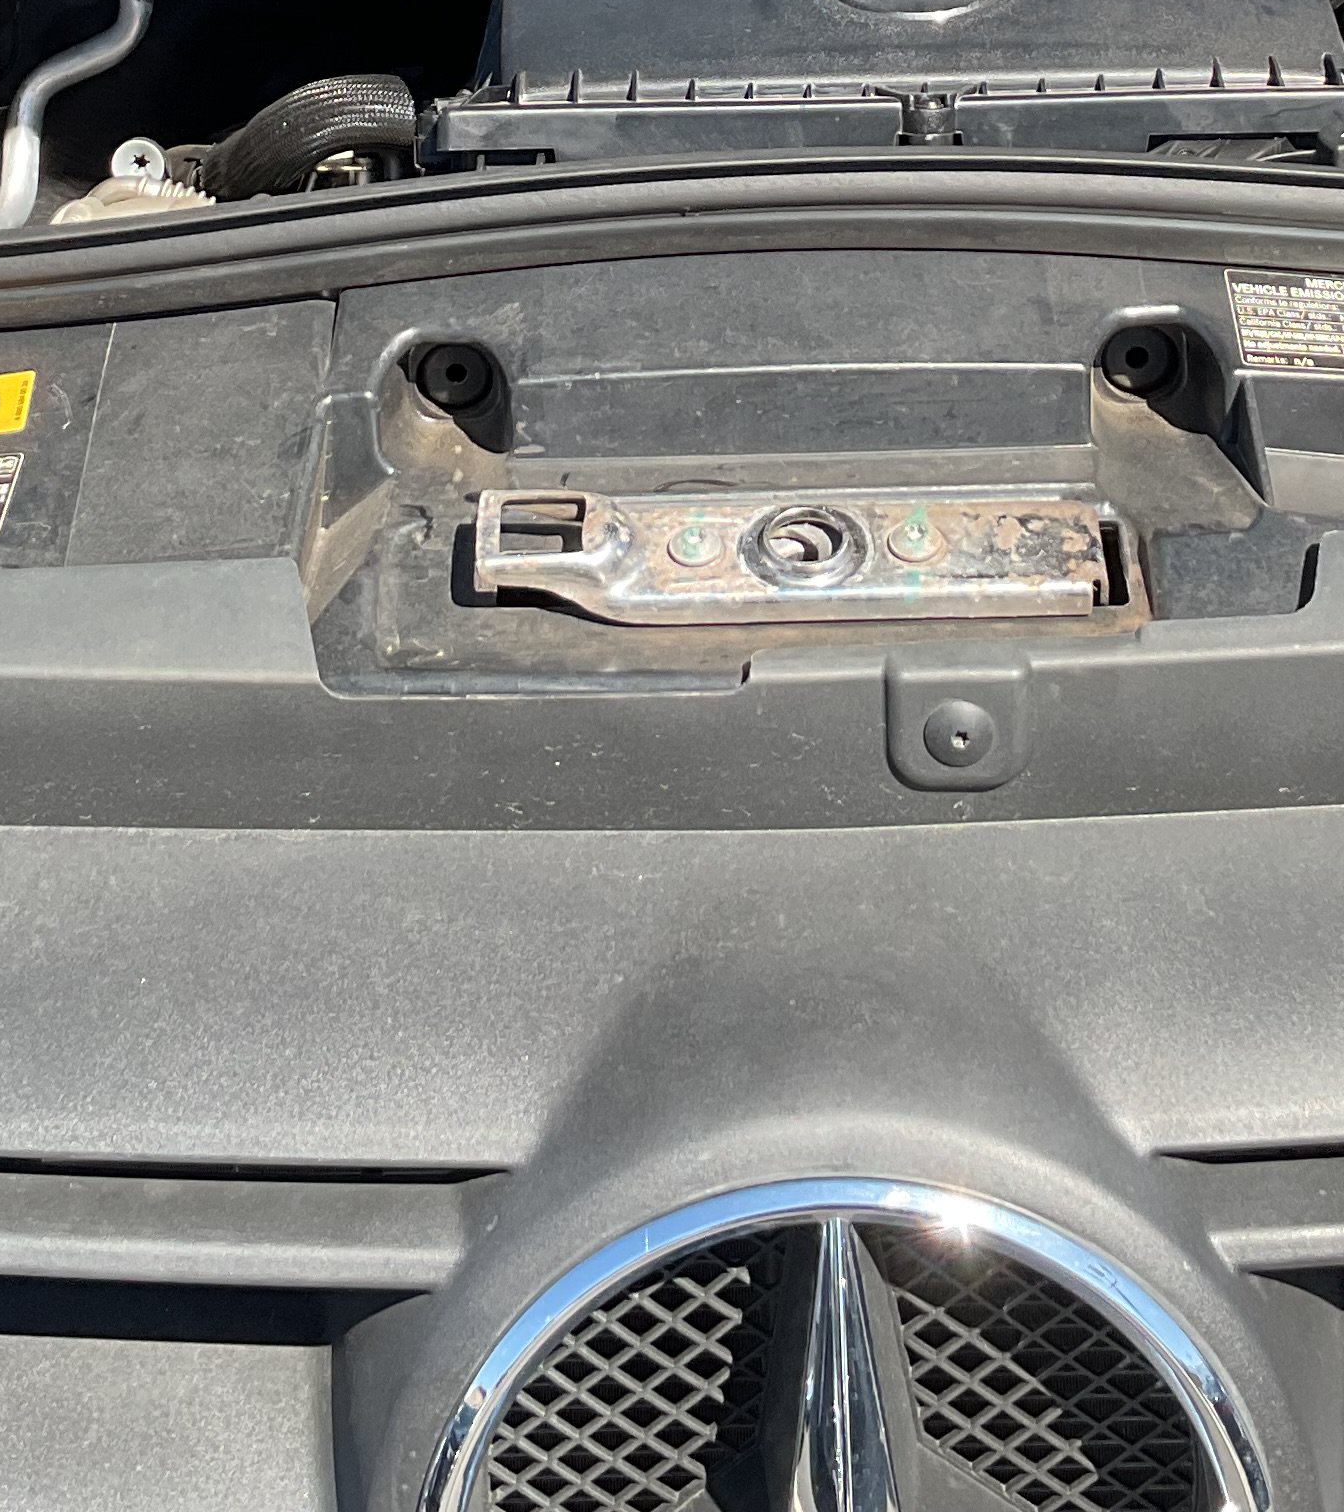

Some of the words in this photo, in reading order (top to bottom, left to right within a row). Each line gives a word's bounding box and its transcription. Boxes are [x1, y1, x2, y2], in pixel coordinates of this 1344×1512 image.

[1232, 283, 1288, 296] VEHICLE
[1234, 295, 1277, 306] Conforms
[1239, 317, 1280, 327] California
